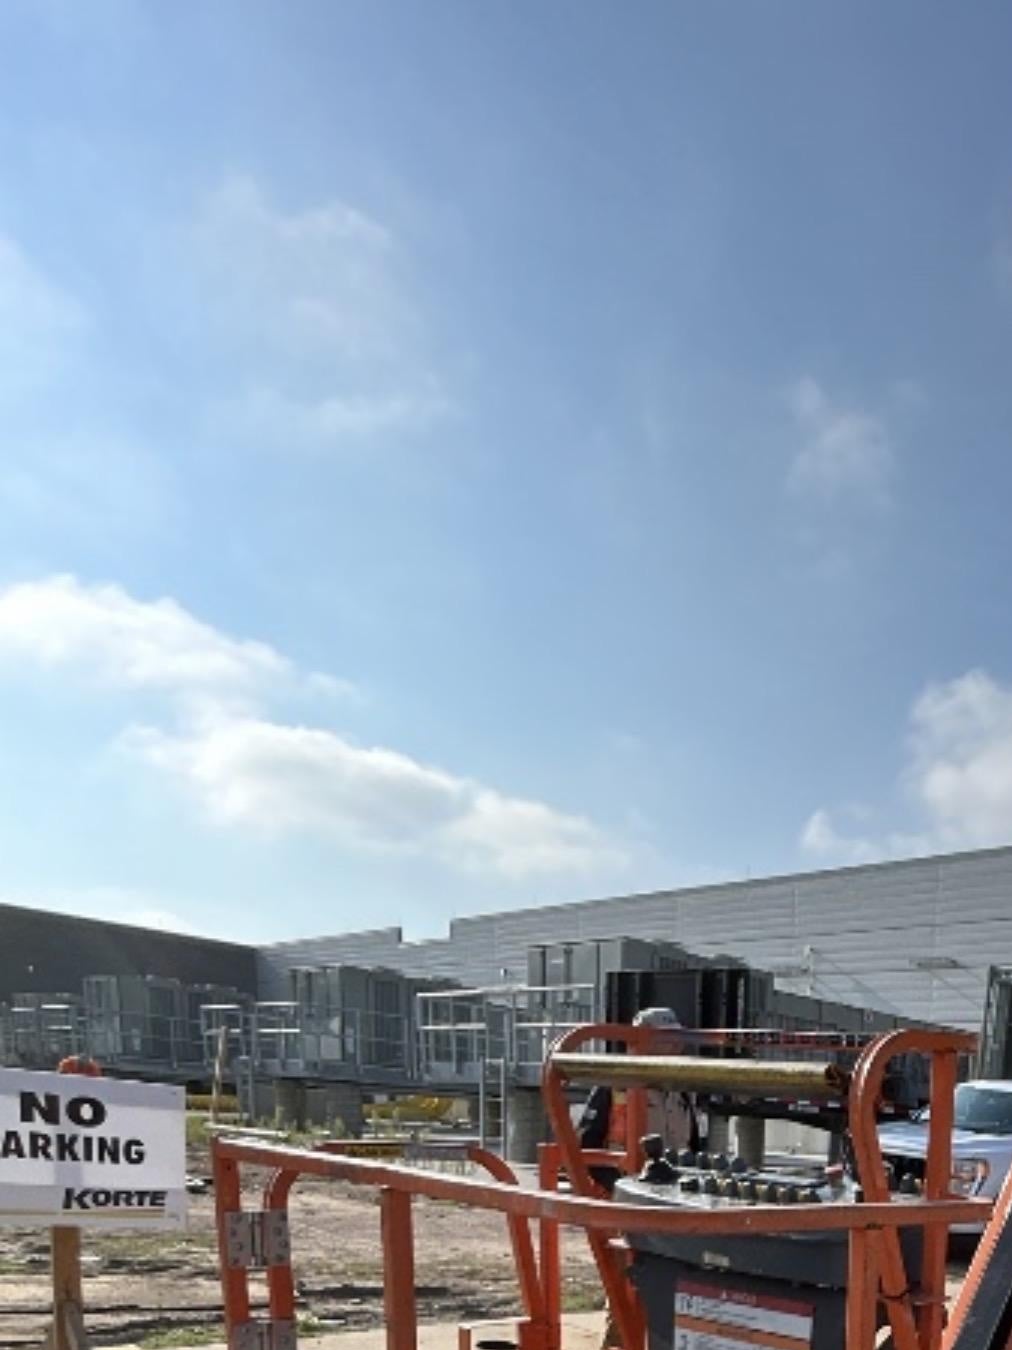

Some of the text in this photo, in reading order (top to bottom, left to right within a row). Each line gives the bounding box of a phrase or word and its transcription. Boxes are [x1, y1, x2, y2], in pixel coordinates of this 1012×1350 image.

[20, 1091, 107, 1128] NO
[0, 1130, 145, 1165] ARKING
[62, 1187, 168, 1209] KORTE
